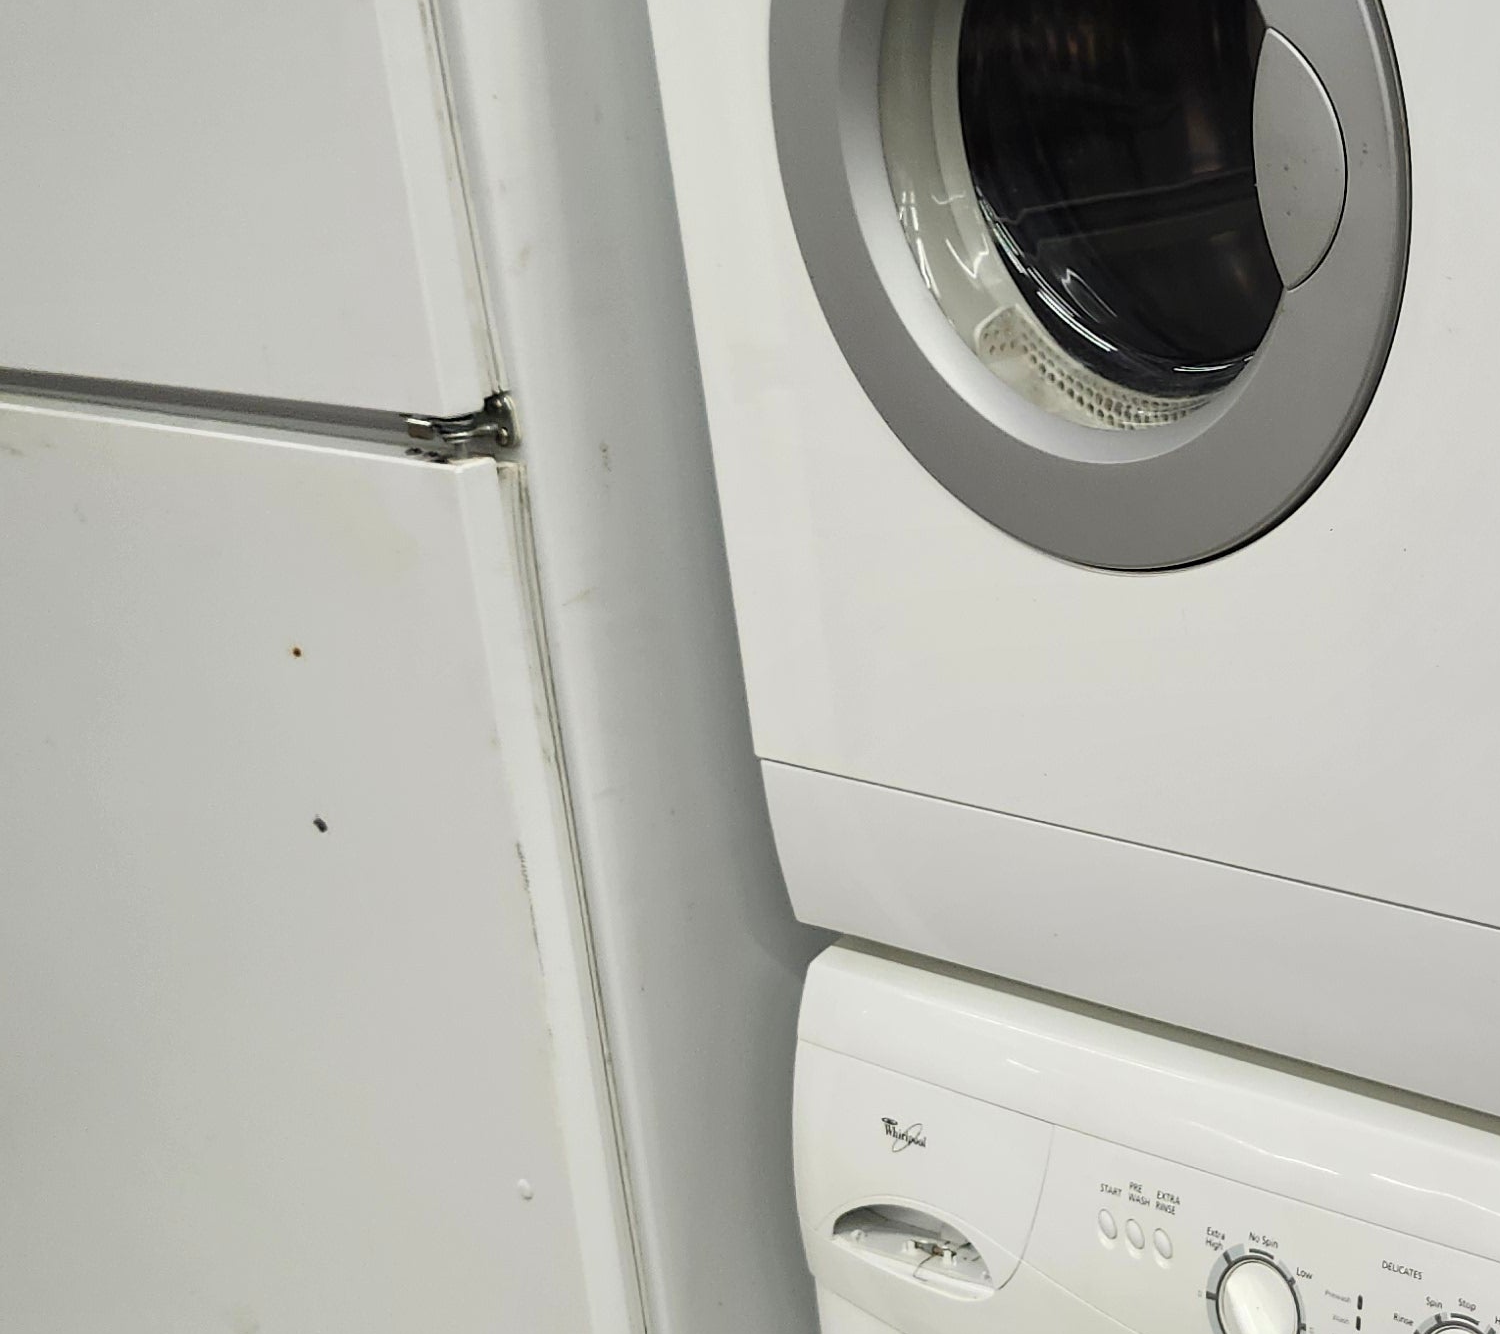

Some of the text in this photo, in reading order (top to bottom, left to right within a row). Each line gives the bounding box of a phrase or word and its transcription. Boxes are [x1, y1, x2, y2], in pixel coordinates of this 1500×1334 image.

[1100, 1183, 1122, 1197] START
[1128, 1181, 1143, 1194] PRE
[1128, 1193, 1151, 1207] WASH
[1156, 1190, 1181, 1206] EXTRA
[1155, 1201, 1176, 1216] RINSE
[1206, 1226, 1226, 1241] Extra
[1249, 1232, 1279, 1250] No Spin
[1205, 1238, 1224, 1252] High
[1296, 1267, 1313, 1280] Low
[1381, 1259, 1424, 1281] DELICATES
[1425, 1296, 1444, 1311] Spin
[1458, 1297, 1477, 1312] Stop
[1393, 1312, 1415, 1327] Rinse
